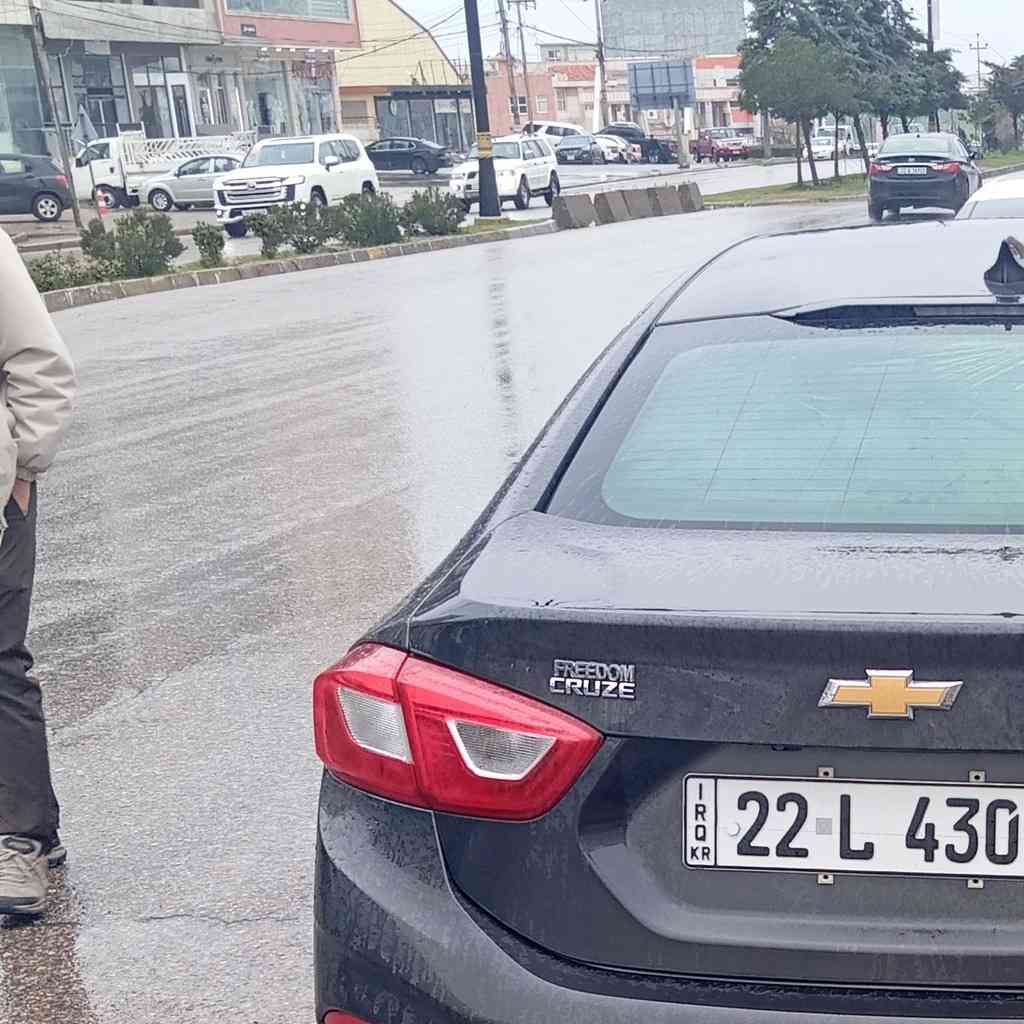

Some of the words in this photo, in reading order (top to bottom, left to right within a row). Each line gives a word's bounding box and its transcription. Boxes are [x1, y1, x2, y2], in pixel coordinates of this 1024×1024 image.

[553, 659, 636, 683] FREEDOM
[549, 676, 636, 699] CRUZE
[736, 791, 809, 858] 22
[839, 794, 874, 861] L
[690, 846, 712, 861] KR
